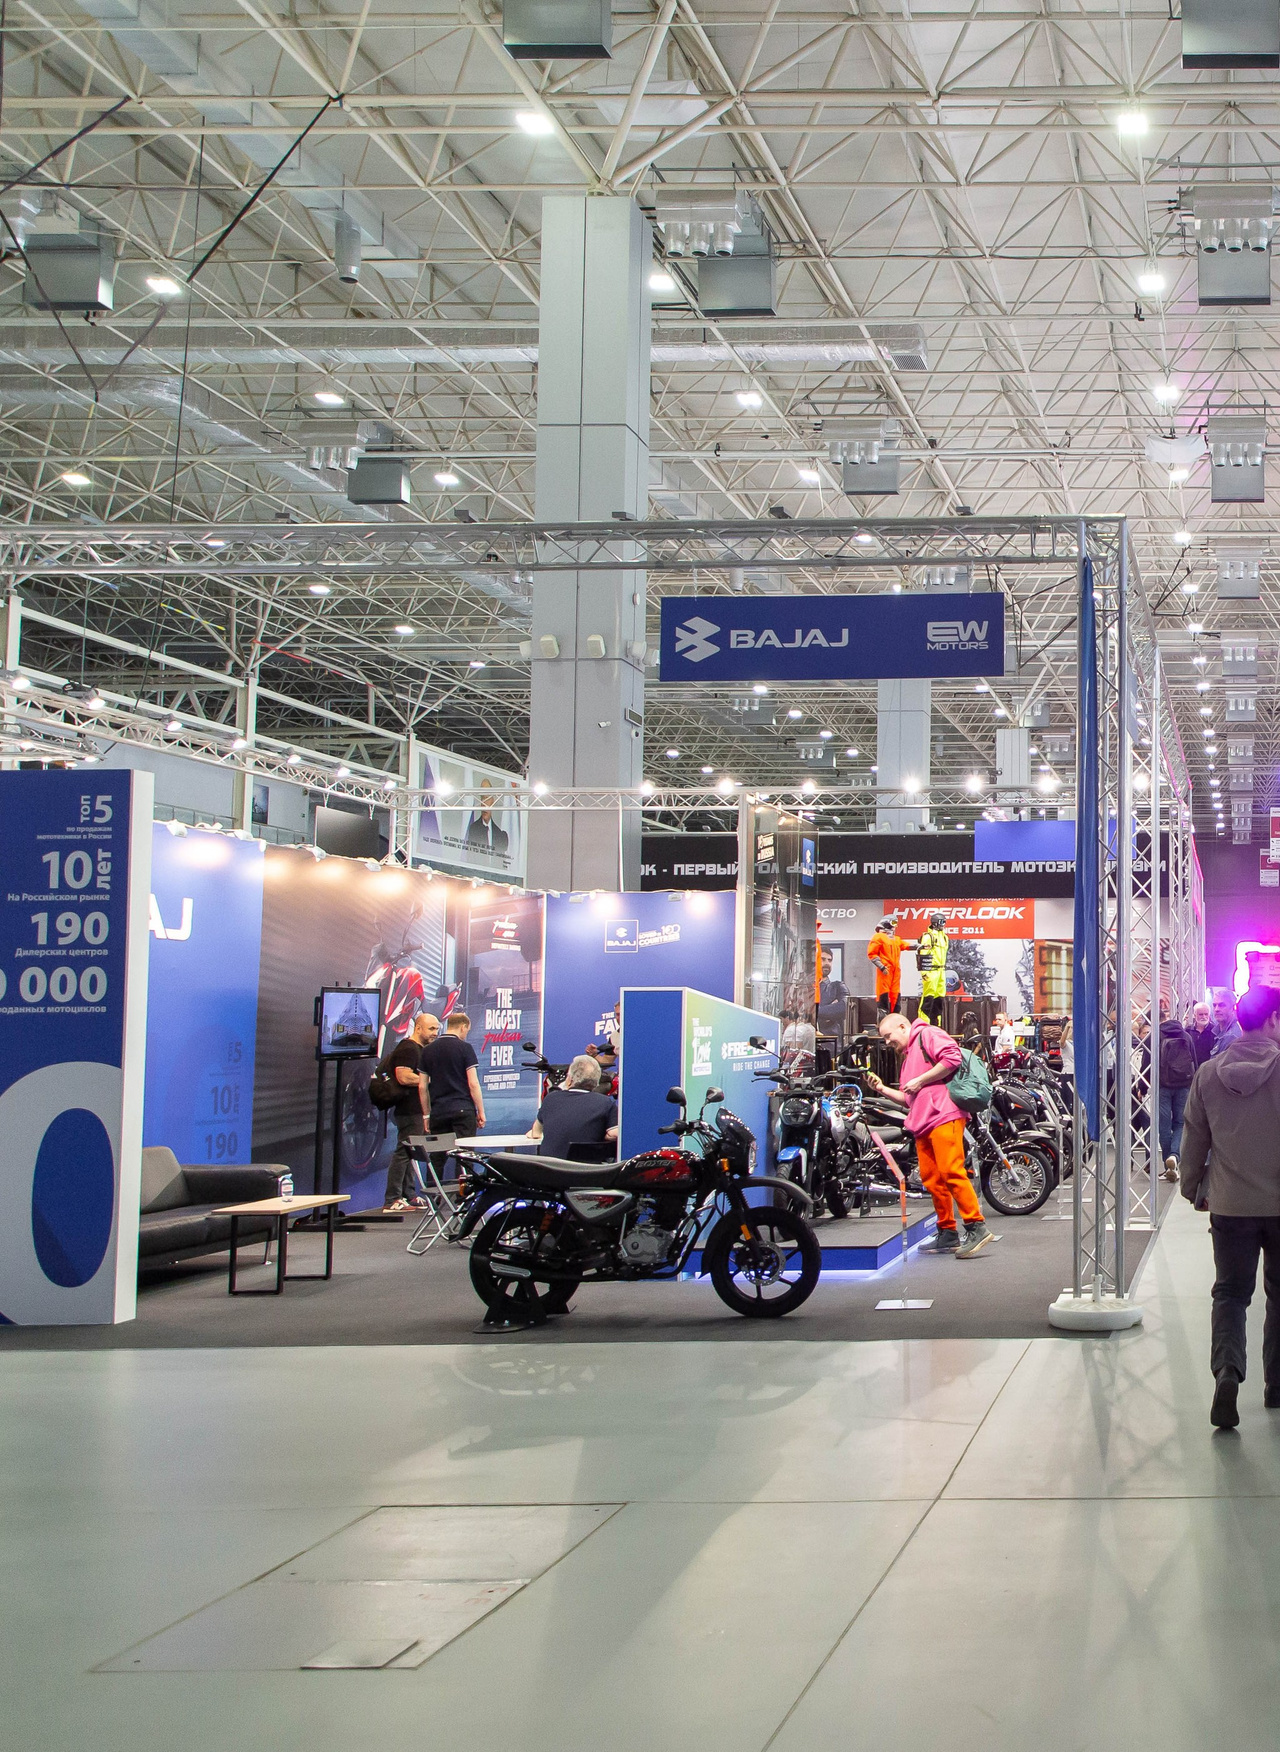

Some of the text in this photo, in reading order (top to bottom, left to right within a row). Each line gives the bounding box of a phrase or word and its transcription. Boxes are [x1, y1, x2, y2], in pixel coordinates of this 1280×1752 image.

[730, 628, 849, 649] BAJAJ
[927, 641, 989, 650] MOTORS
[93, 795, 113, 824] 5
[42, 848, 112, 890] 10 лет
[863, 861, 1004, 874] ПРОИЗВОДИТЕЛЬ
[7, 893, 110, 902] На Российском рынке
[893, 906, 1027, 920] HYPERLOOK
[31, 911, 109, 945] 190
[961, 926, 985, 935] 2011
[15, 948, 108, 958] Дилерских центров
[496, 987, 513, 1009] THE
[47, 1006, 107, 1014] мотоциклов
[601, 1011, 615, 1020] THE
[485, 1009, 522, 1030] BIGGEST
[490, 1045, 514, 1067] EVER
[733, 1060, 771, 1071] RIDE THE CHANGE
[205, 1131, 239, 1160] 190
